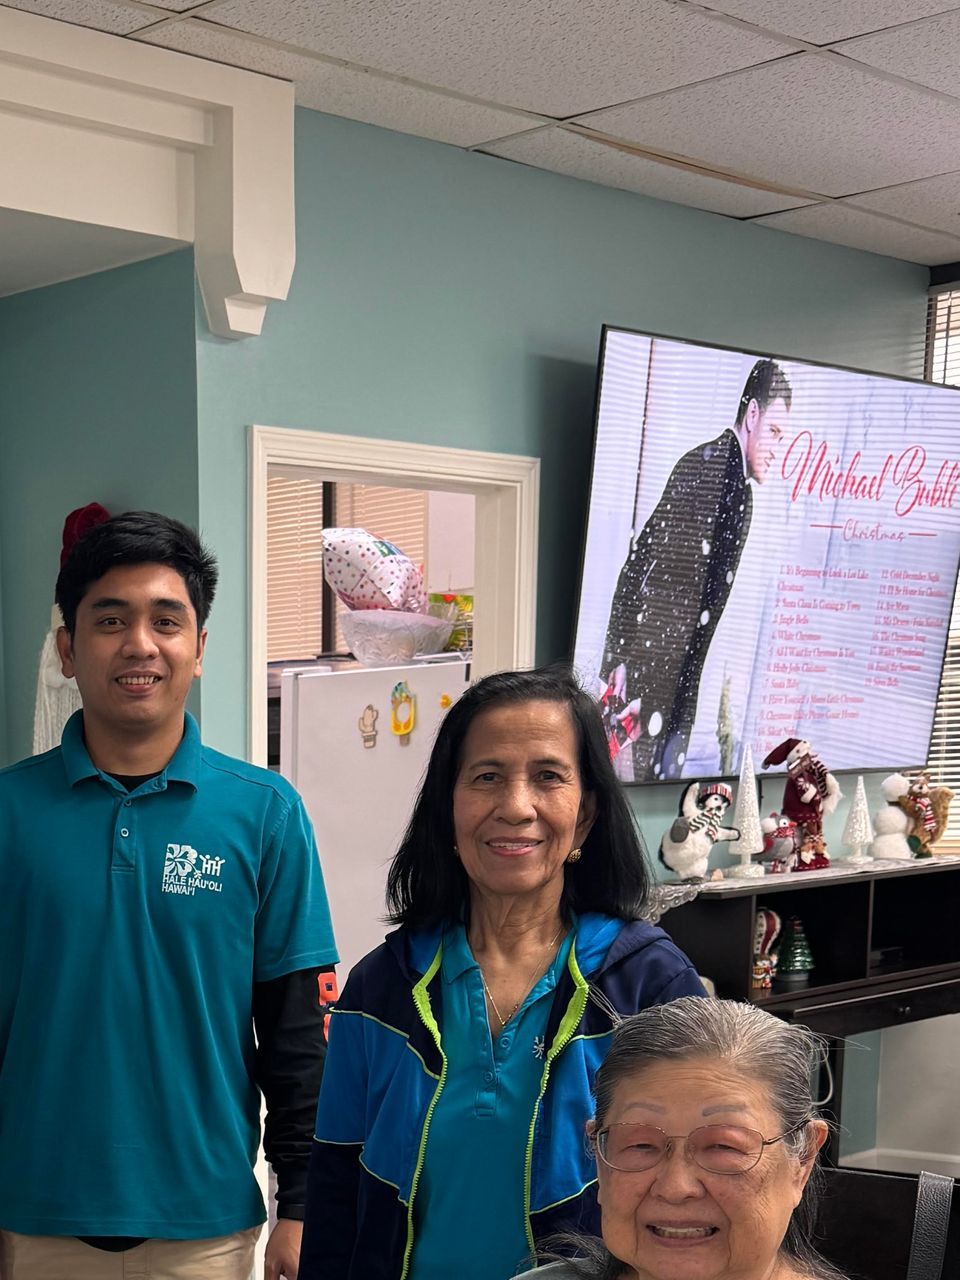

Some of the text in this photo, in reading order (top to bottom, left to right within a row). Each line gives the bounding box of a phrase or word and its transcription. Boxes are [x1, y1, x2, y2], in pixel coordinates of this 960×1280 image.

[781, 430, 894, 502] Michael
[843, 518, 906, 542] Christmas
[163, 873, 187, 885] HALE
